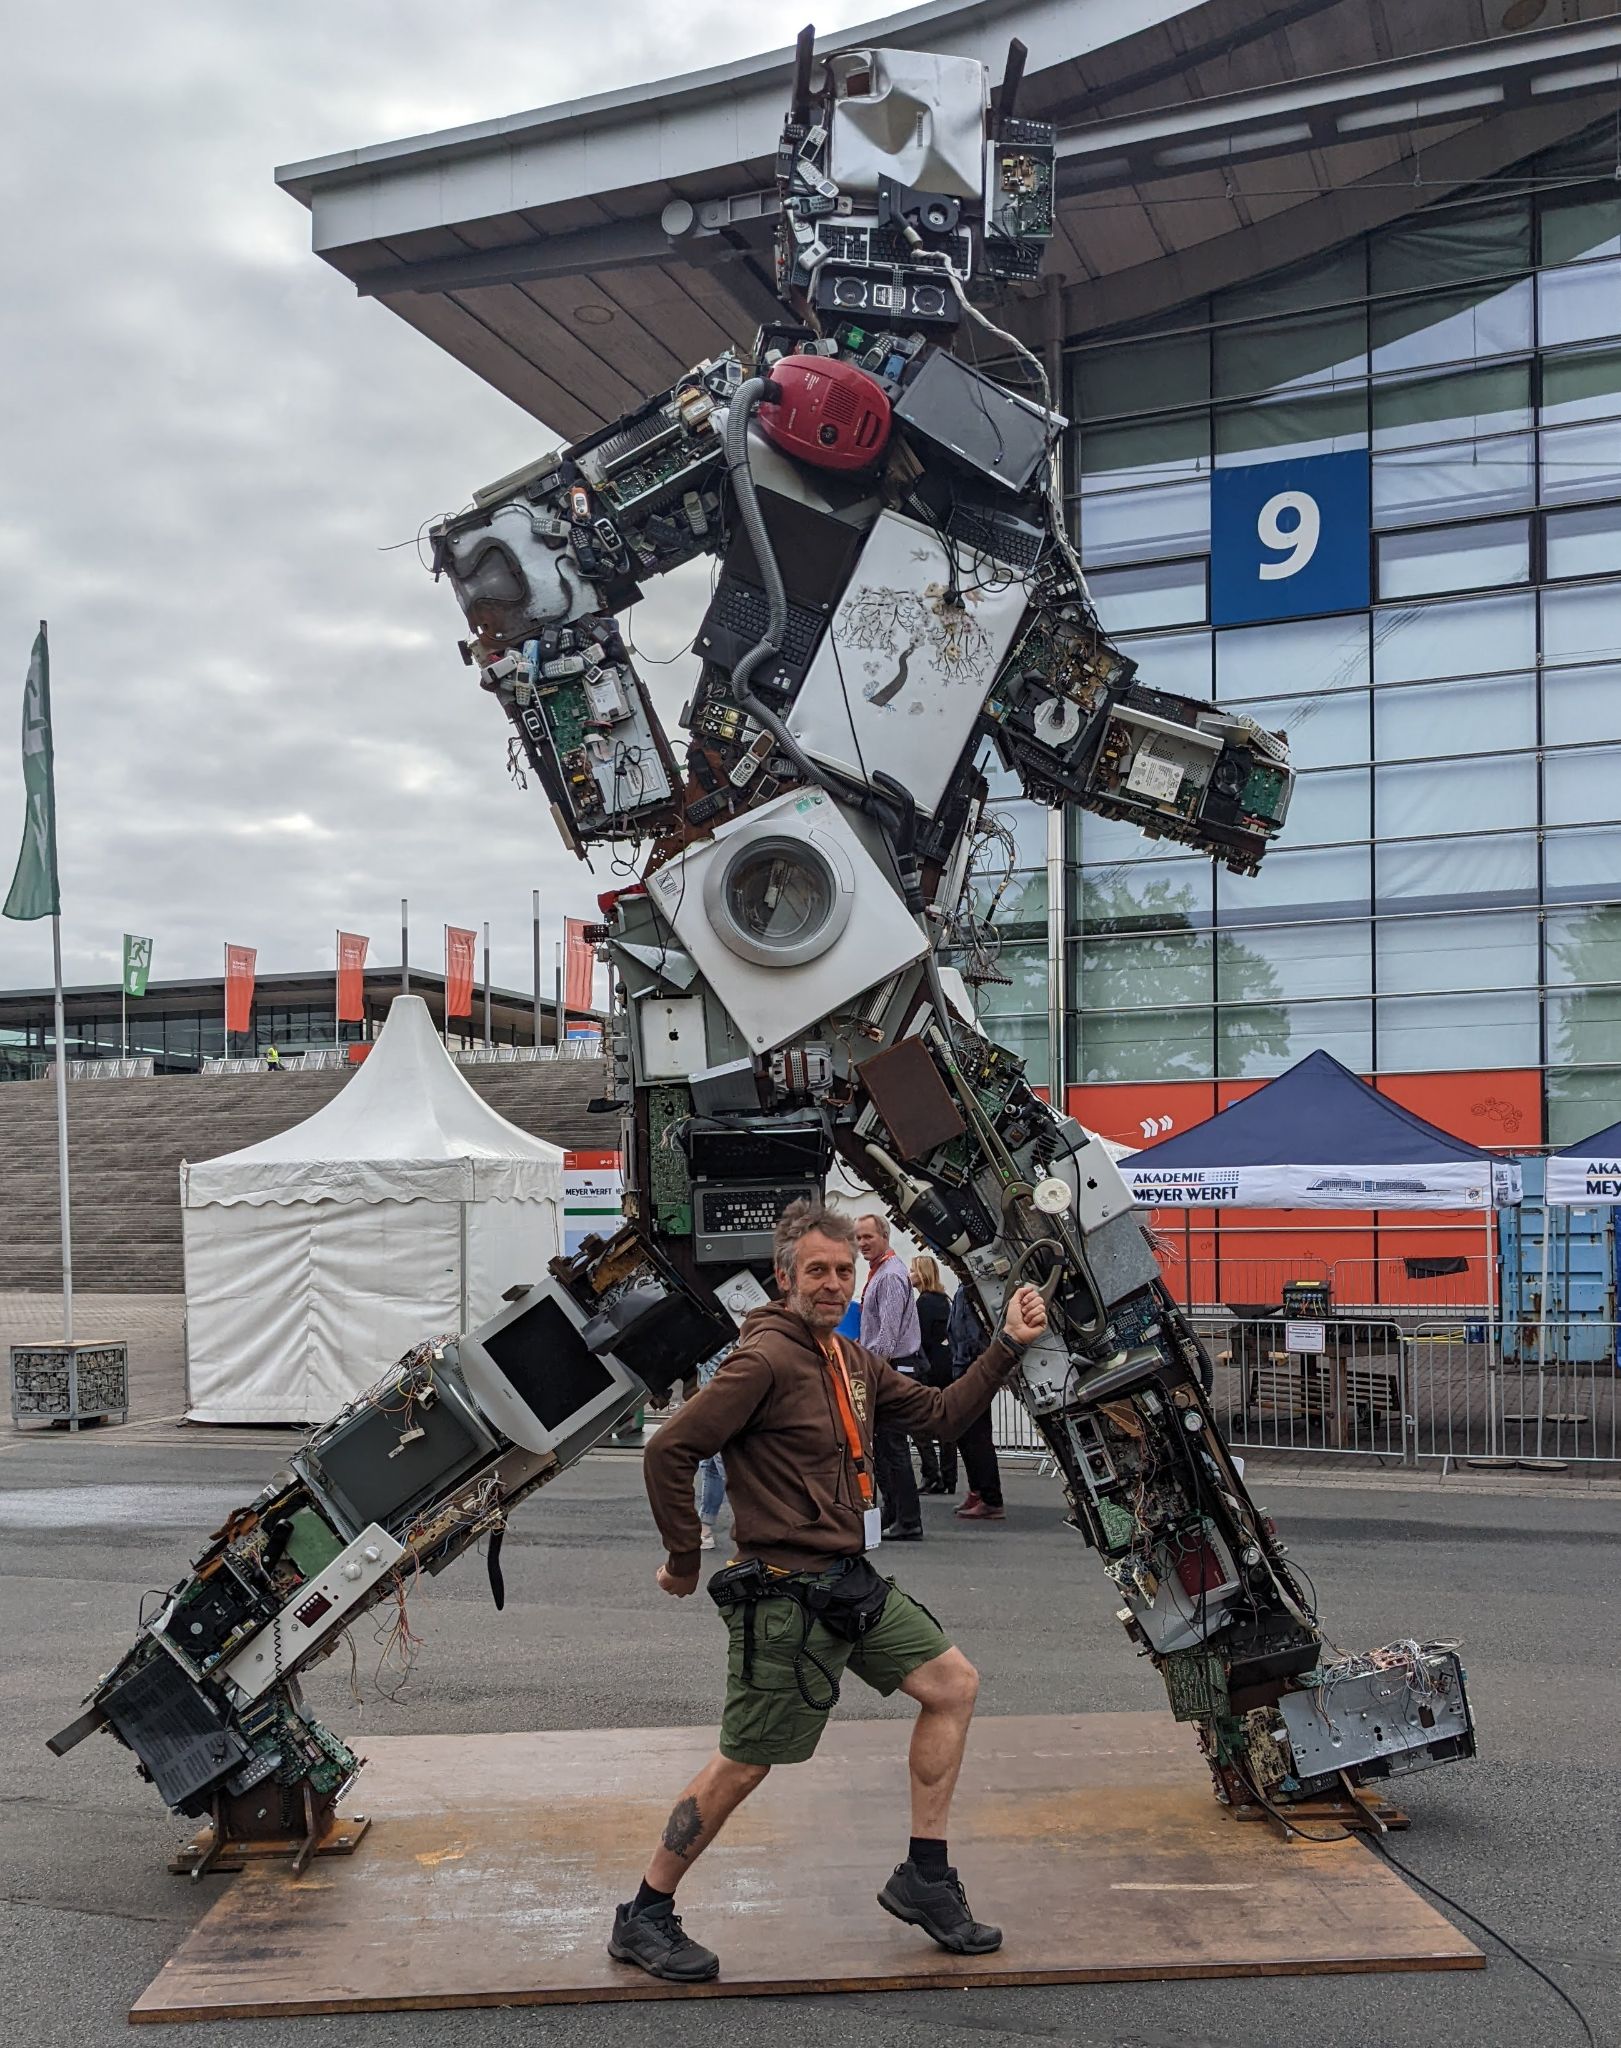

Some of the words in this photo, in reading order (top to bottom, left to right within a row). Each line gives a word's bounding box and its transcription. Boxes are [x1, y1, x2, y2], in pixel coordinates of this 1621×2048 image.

[1257, 490, 1321, 581] 9
[1133, 1172, 1206, 1184] AKADEMIE
[566, 1188, 588, 1196] MEYER
[1133, 1187, 1183, 1204] MEYER
[1185, 1186, 1239, 1201] WERFT
